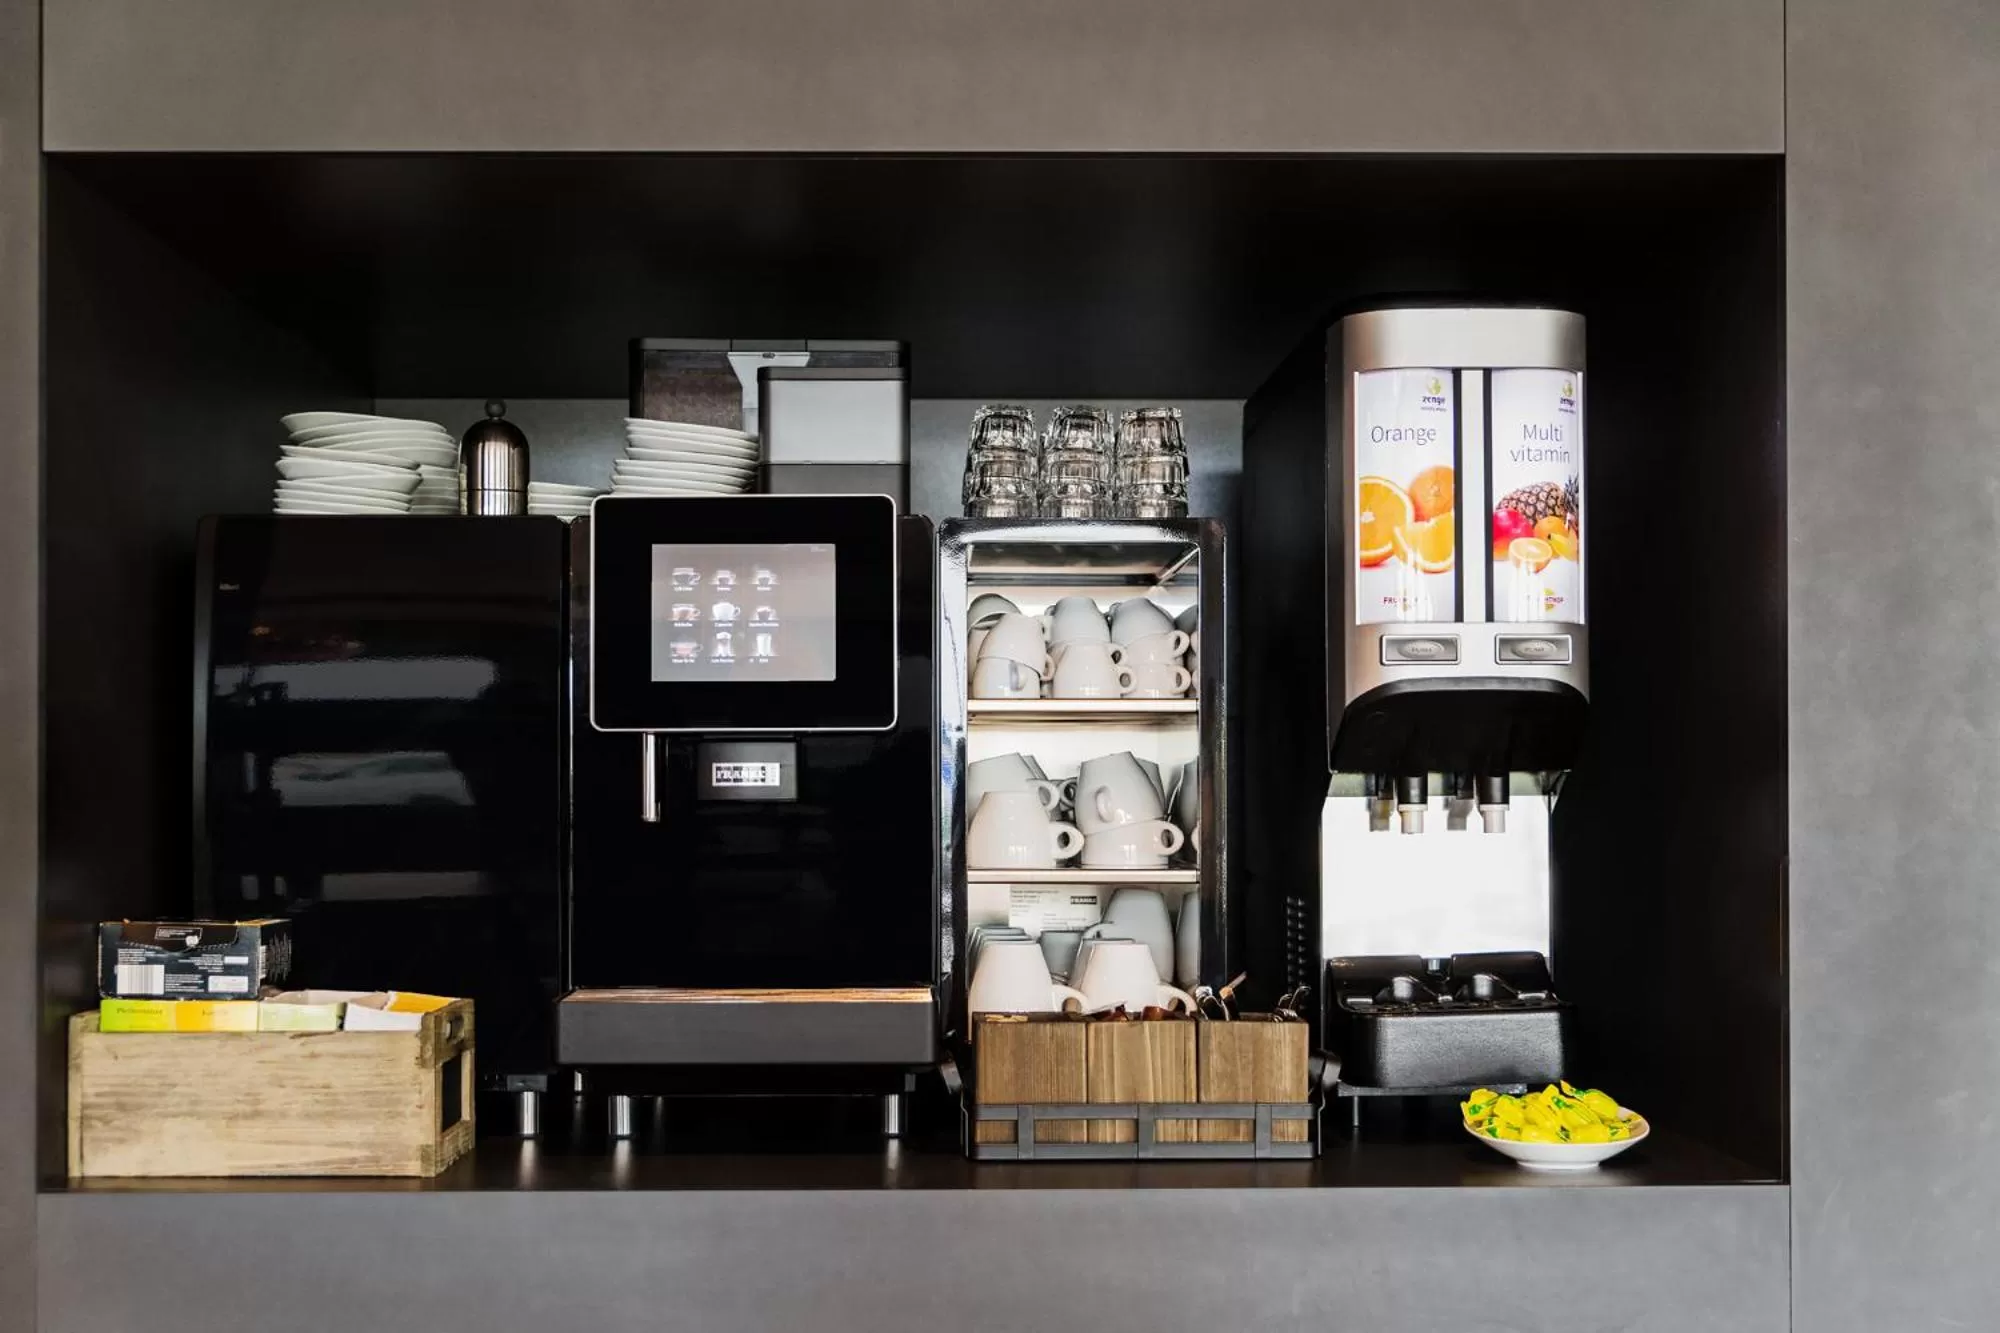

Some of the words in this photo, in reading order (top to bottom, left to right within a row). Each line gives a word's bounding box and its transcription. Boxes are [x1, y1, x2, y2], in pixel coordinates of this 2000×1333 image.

[1371, 425, 1437, 446] Orange
[1523, 423, 1563, 442] Multi
[1510, 445, 1571, 464] vitamin
